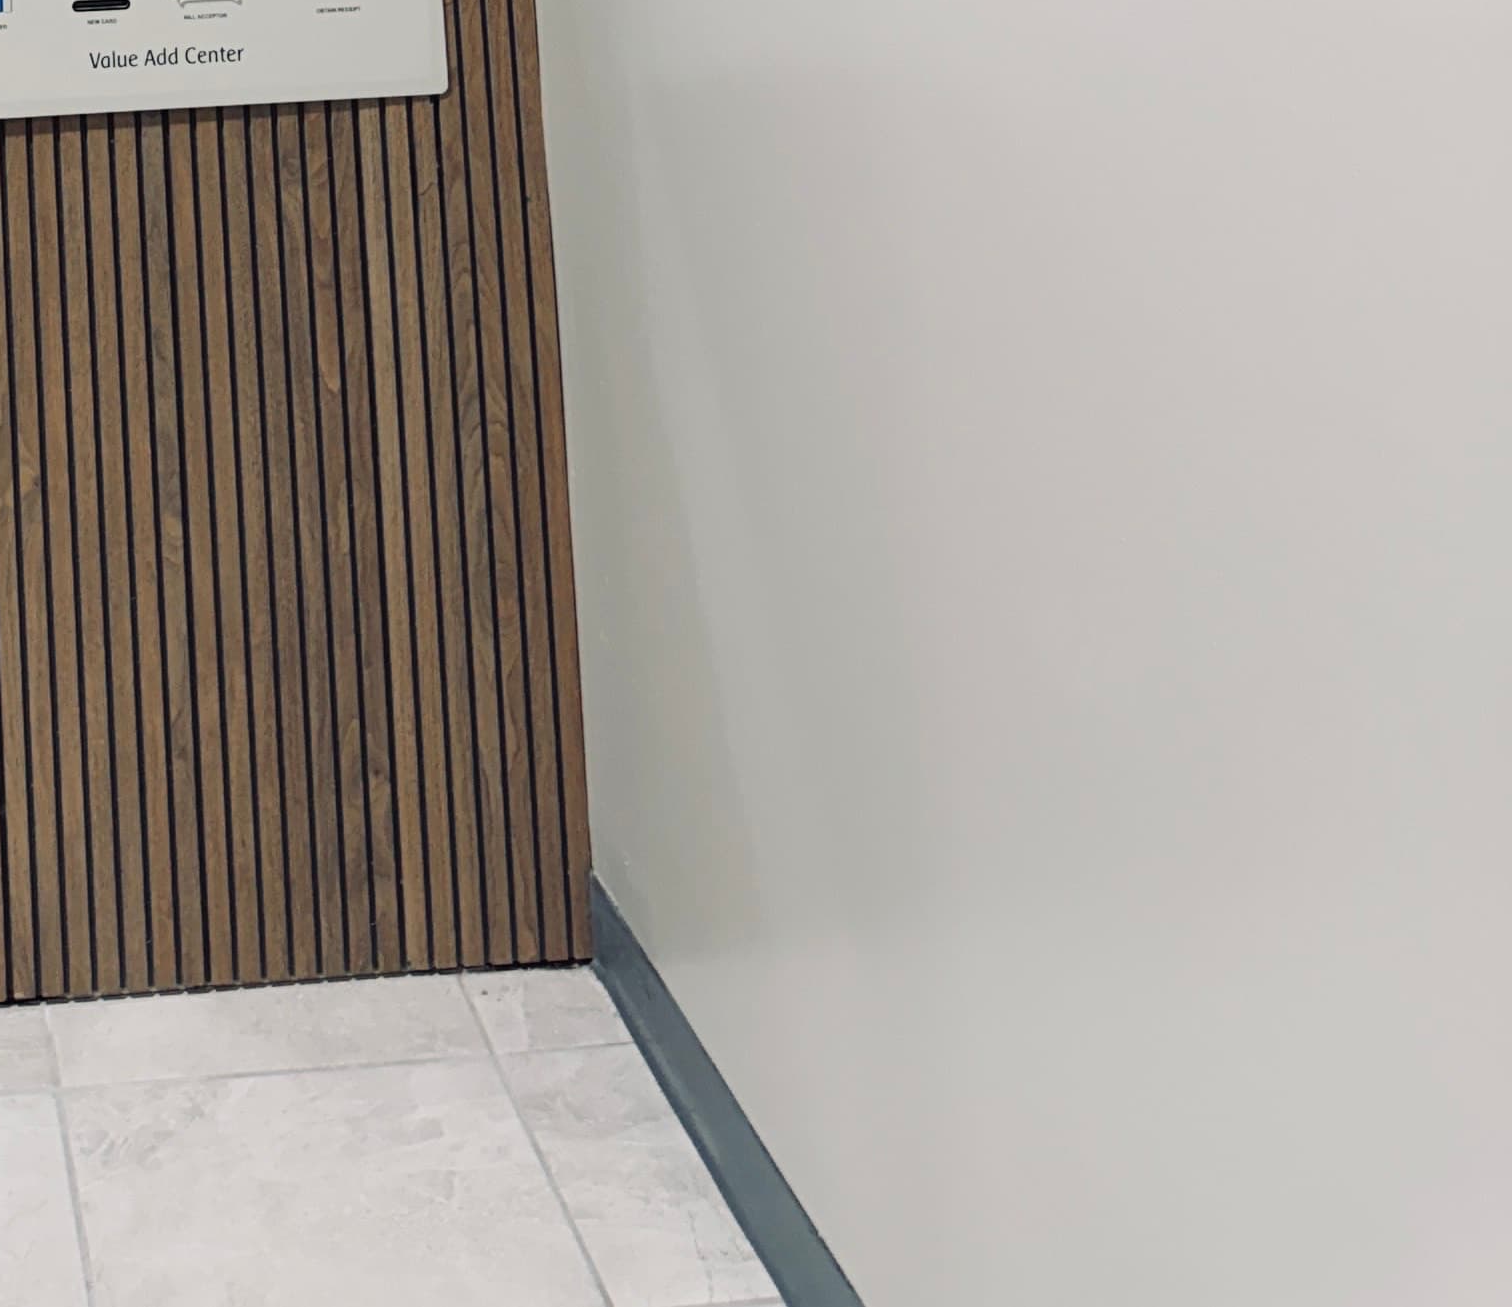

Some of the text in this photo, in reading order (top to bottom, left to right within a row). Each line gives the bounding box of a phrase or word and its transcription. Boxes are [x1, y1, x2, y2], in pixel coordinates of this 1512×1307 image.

[89, 46, 244, 69] Value Add Center
